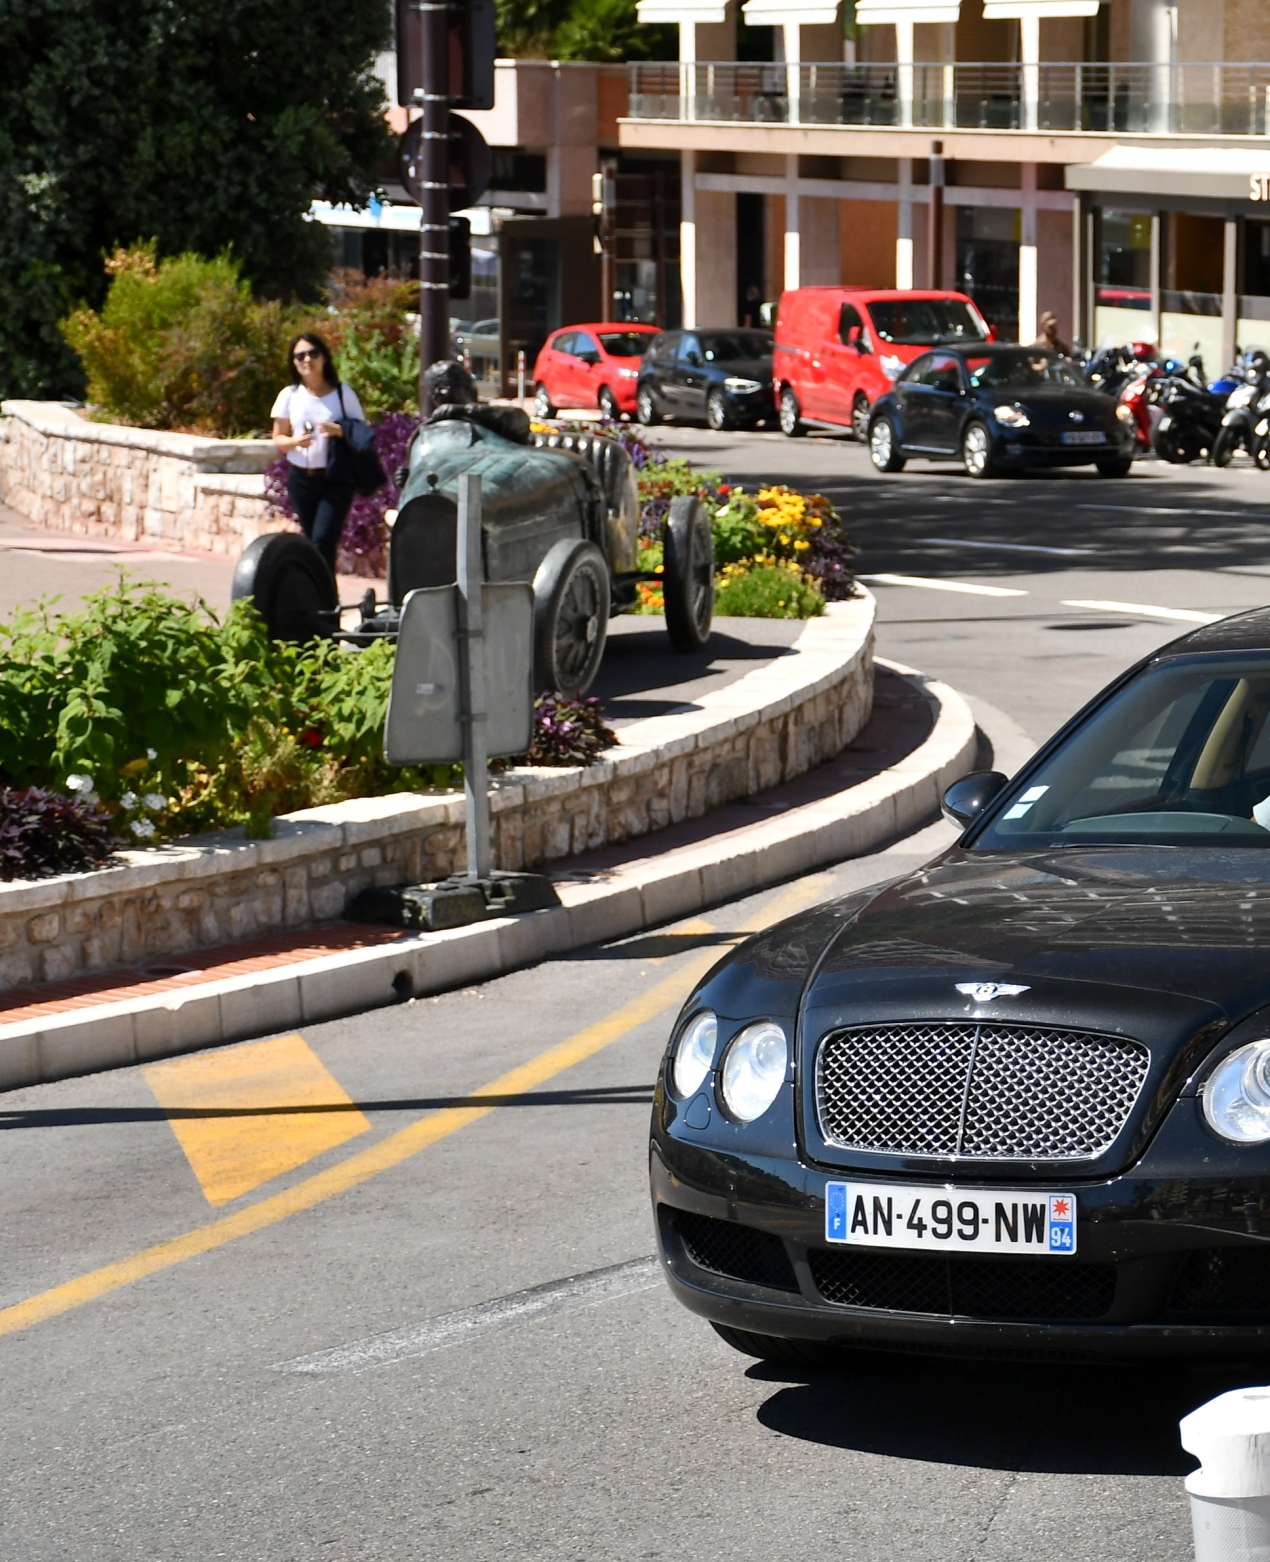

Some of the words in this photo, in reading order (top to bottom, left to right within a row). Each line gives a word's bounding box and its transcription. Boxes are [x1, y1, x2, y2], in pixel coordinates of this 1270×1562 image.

[833, 1217, 841, 1230] F
[850, 1193, 1047, 1244] AN-499-NW
[1051, 1226, 1072, 1248] 94
